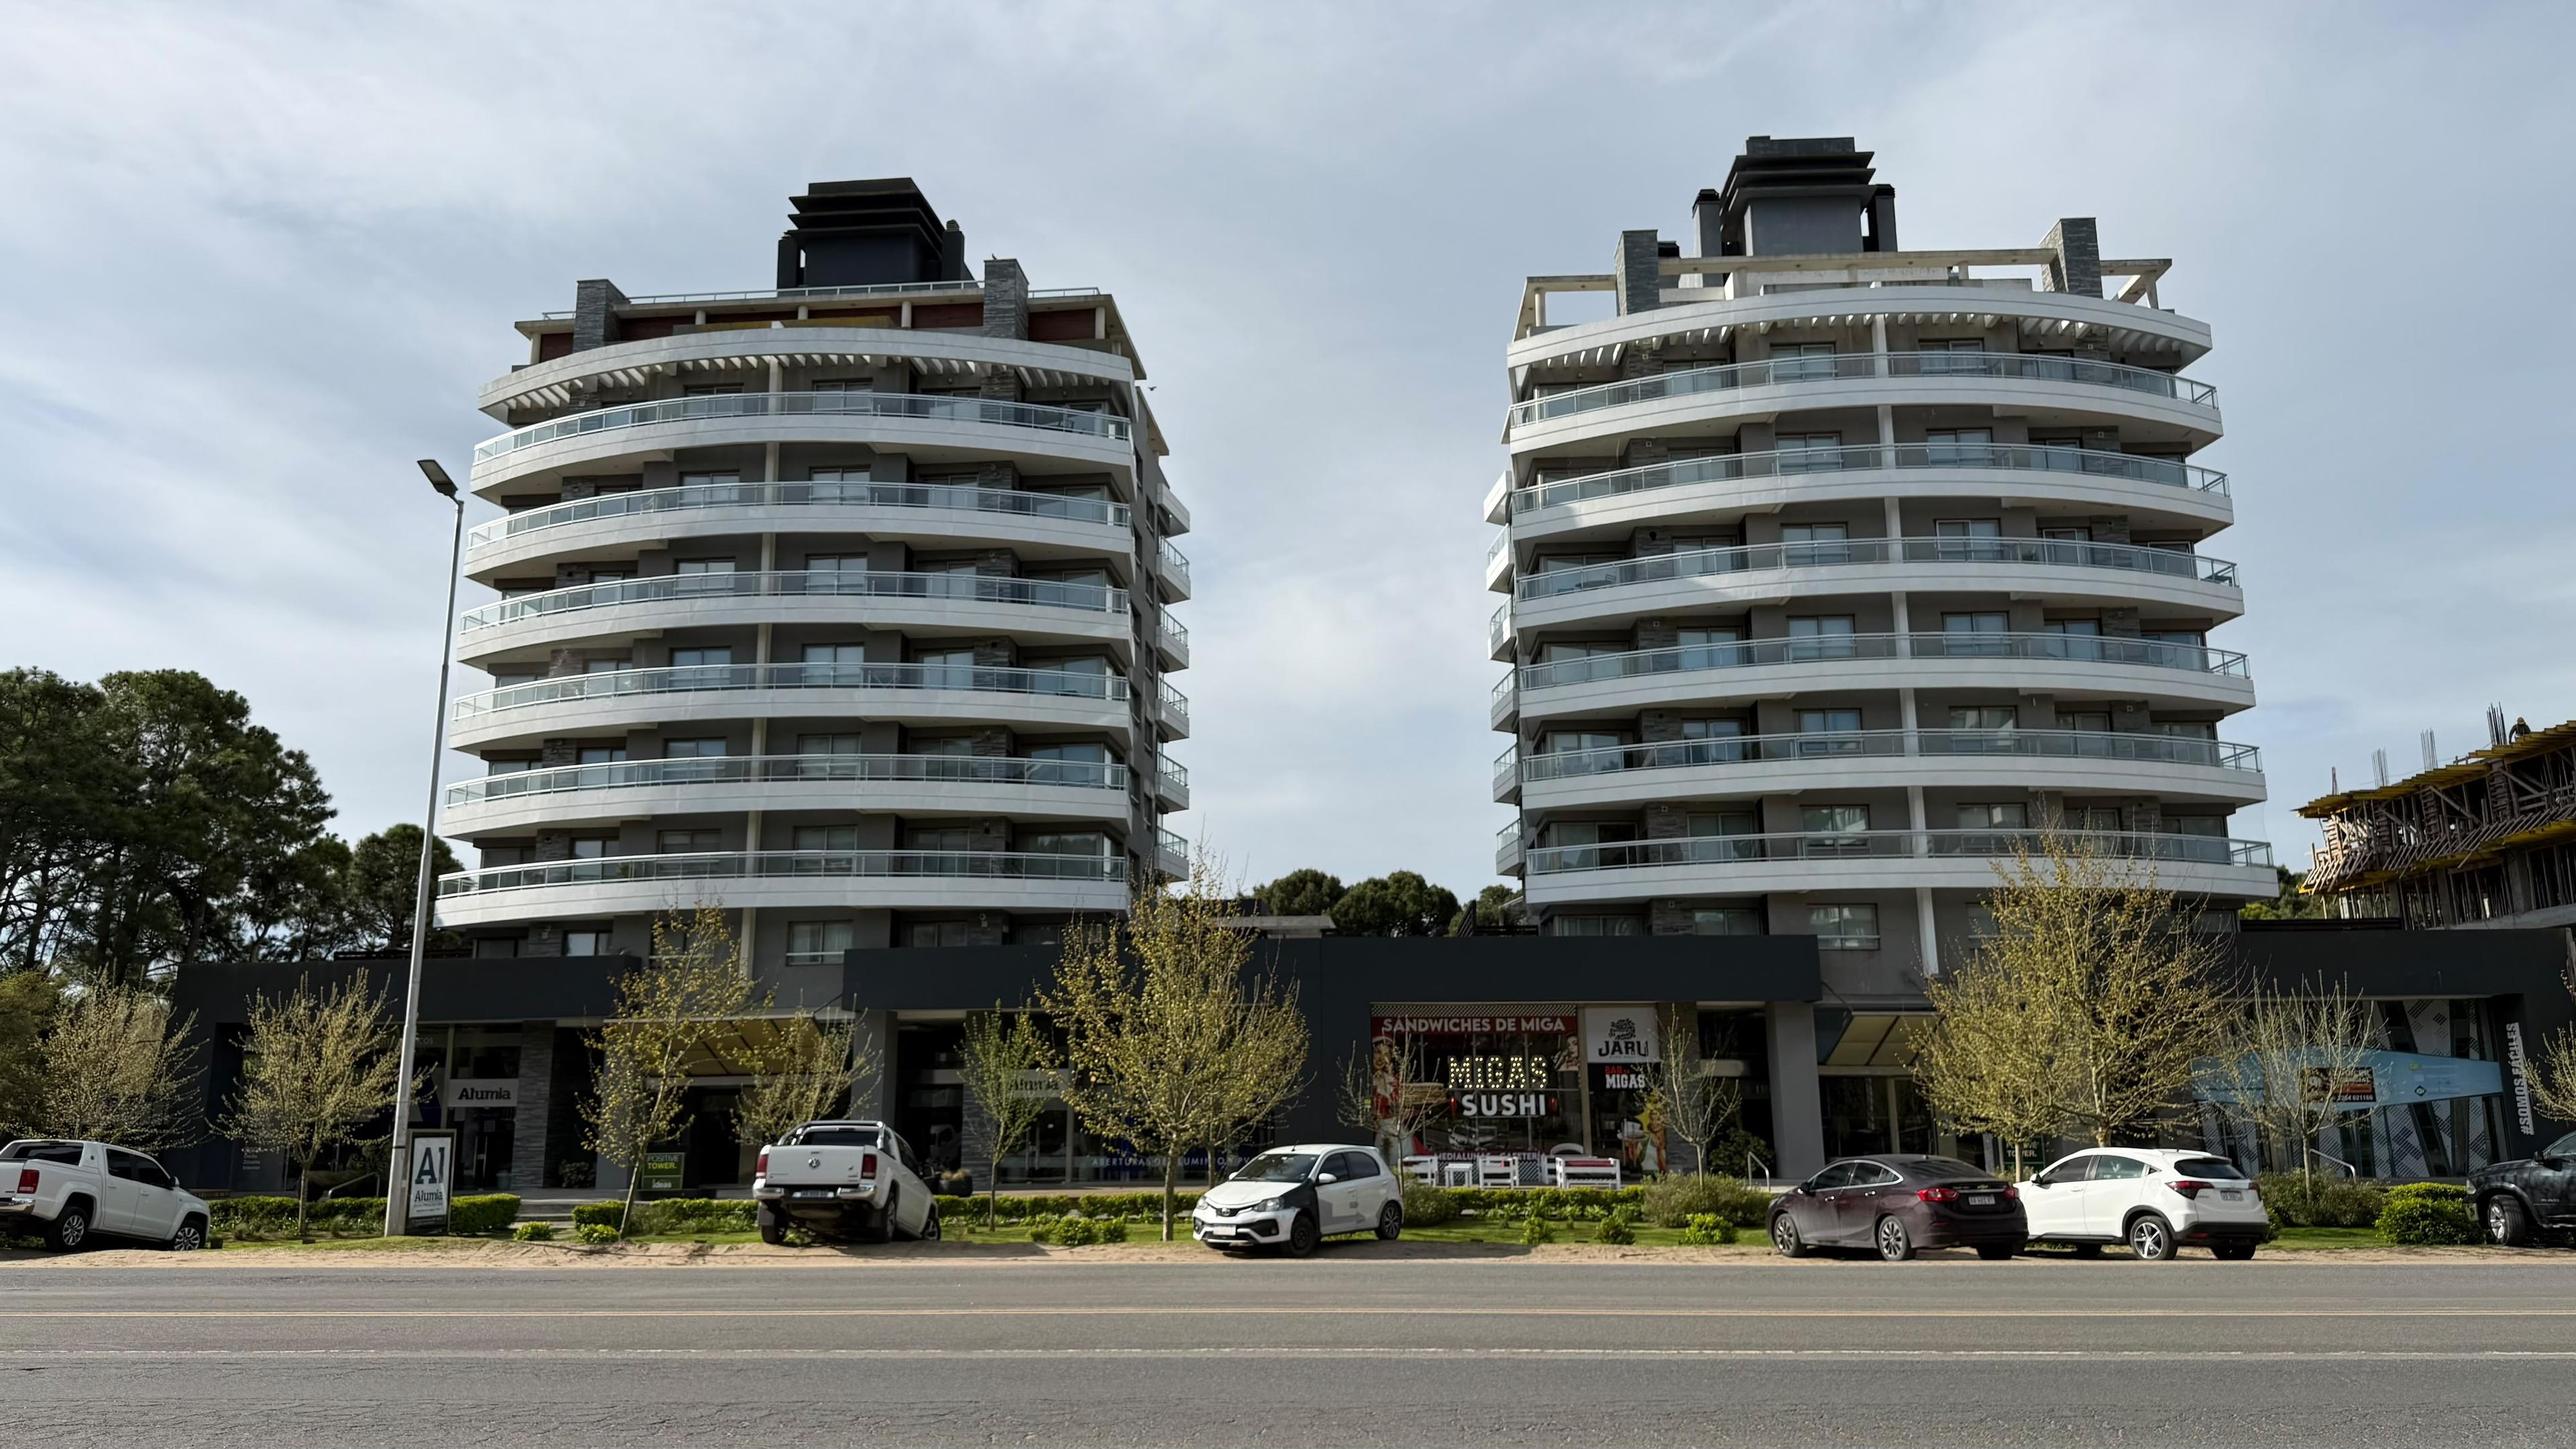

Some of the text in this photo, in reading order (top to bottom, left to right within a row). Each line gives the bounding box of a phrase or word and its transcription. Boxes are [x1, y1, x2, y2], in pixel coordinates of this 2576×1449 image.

[1383, 1018, 1565, 1032] SANDWICHES DE MIGA
[1598, 1040, 1649, 1057] JARU
[1448, 1055, 1548, 1089] MIGAS
[1605, 1065, 1623, 1073] BAR
[1605, 1074, 1646, 1089] MIGAS
[458, 1087, 511, 1100] Alumia
[1461, 1094, 1546, 1116] SUSHI
[414, 1189, 443, 1202] Alumia
